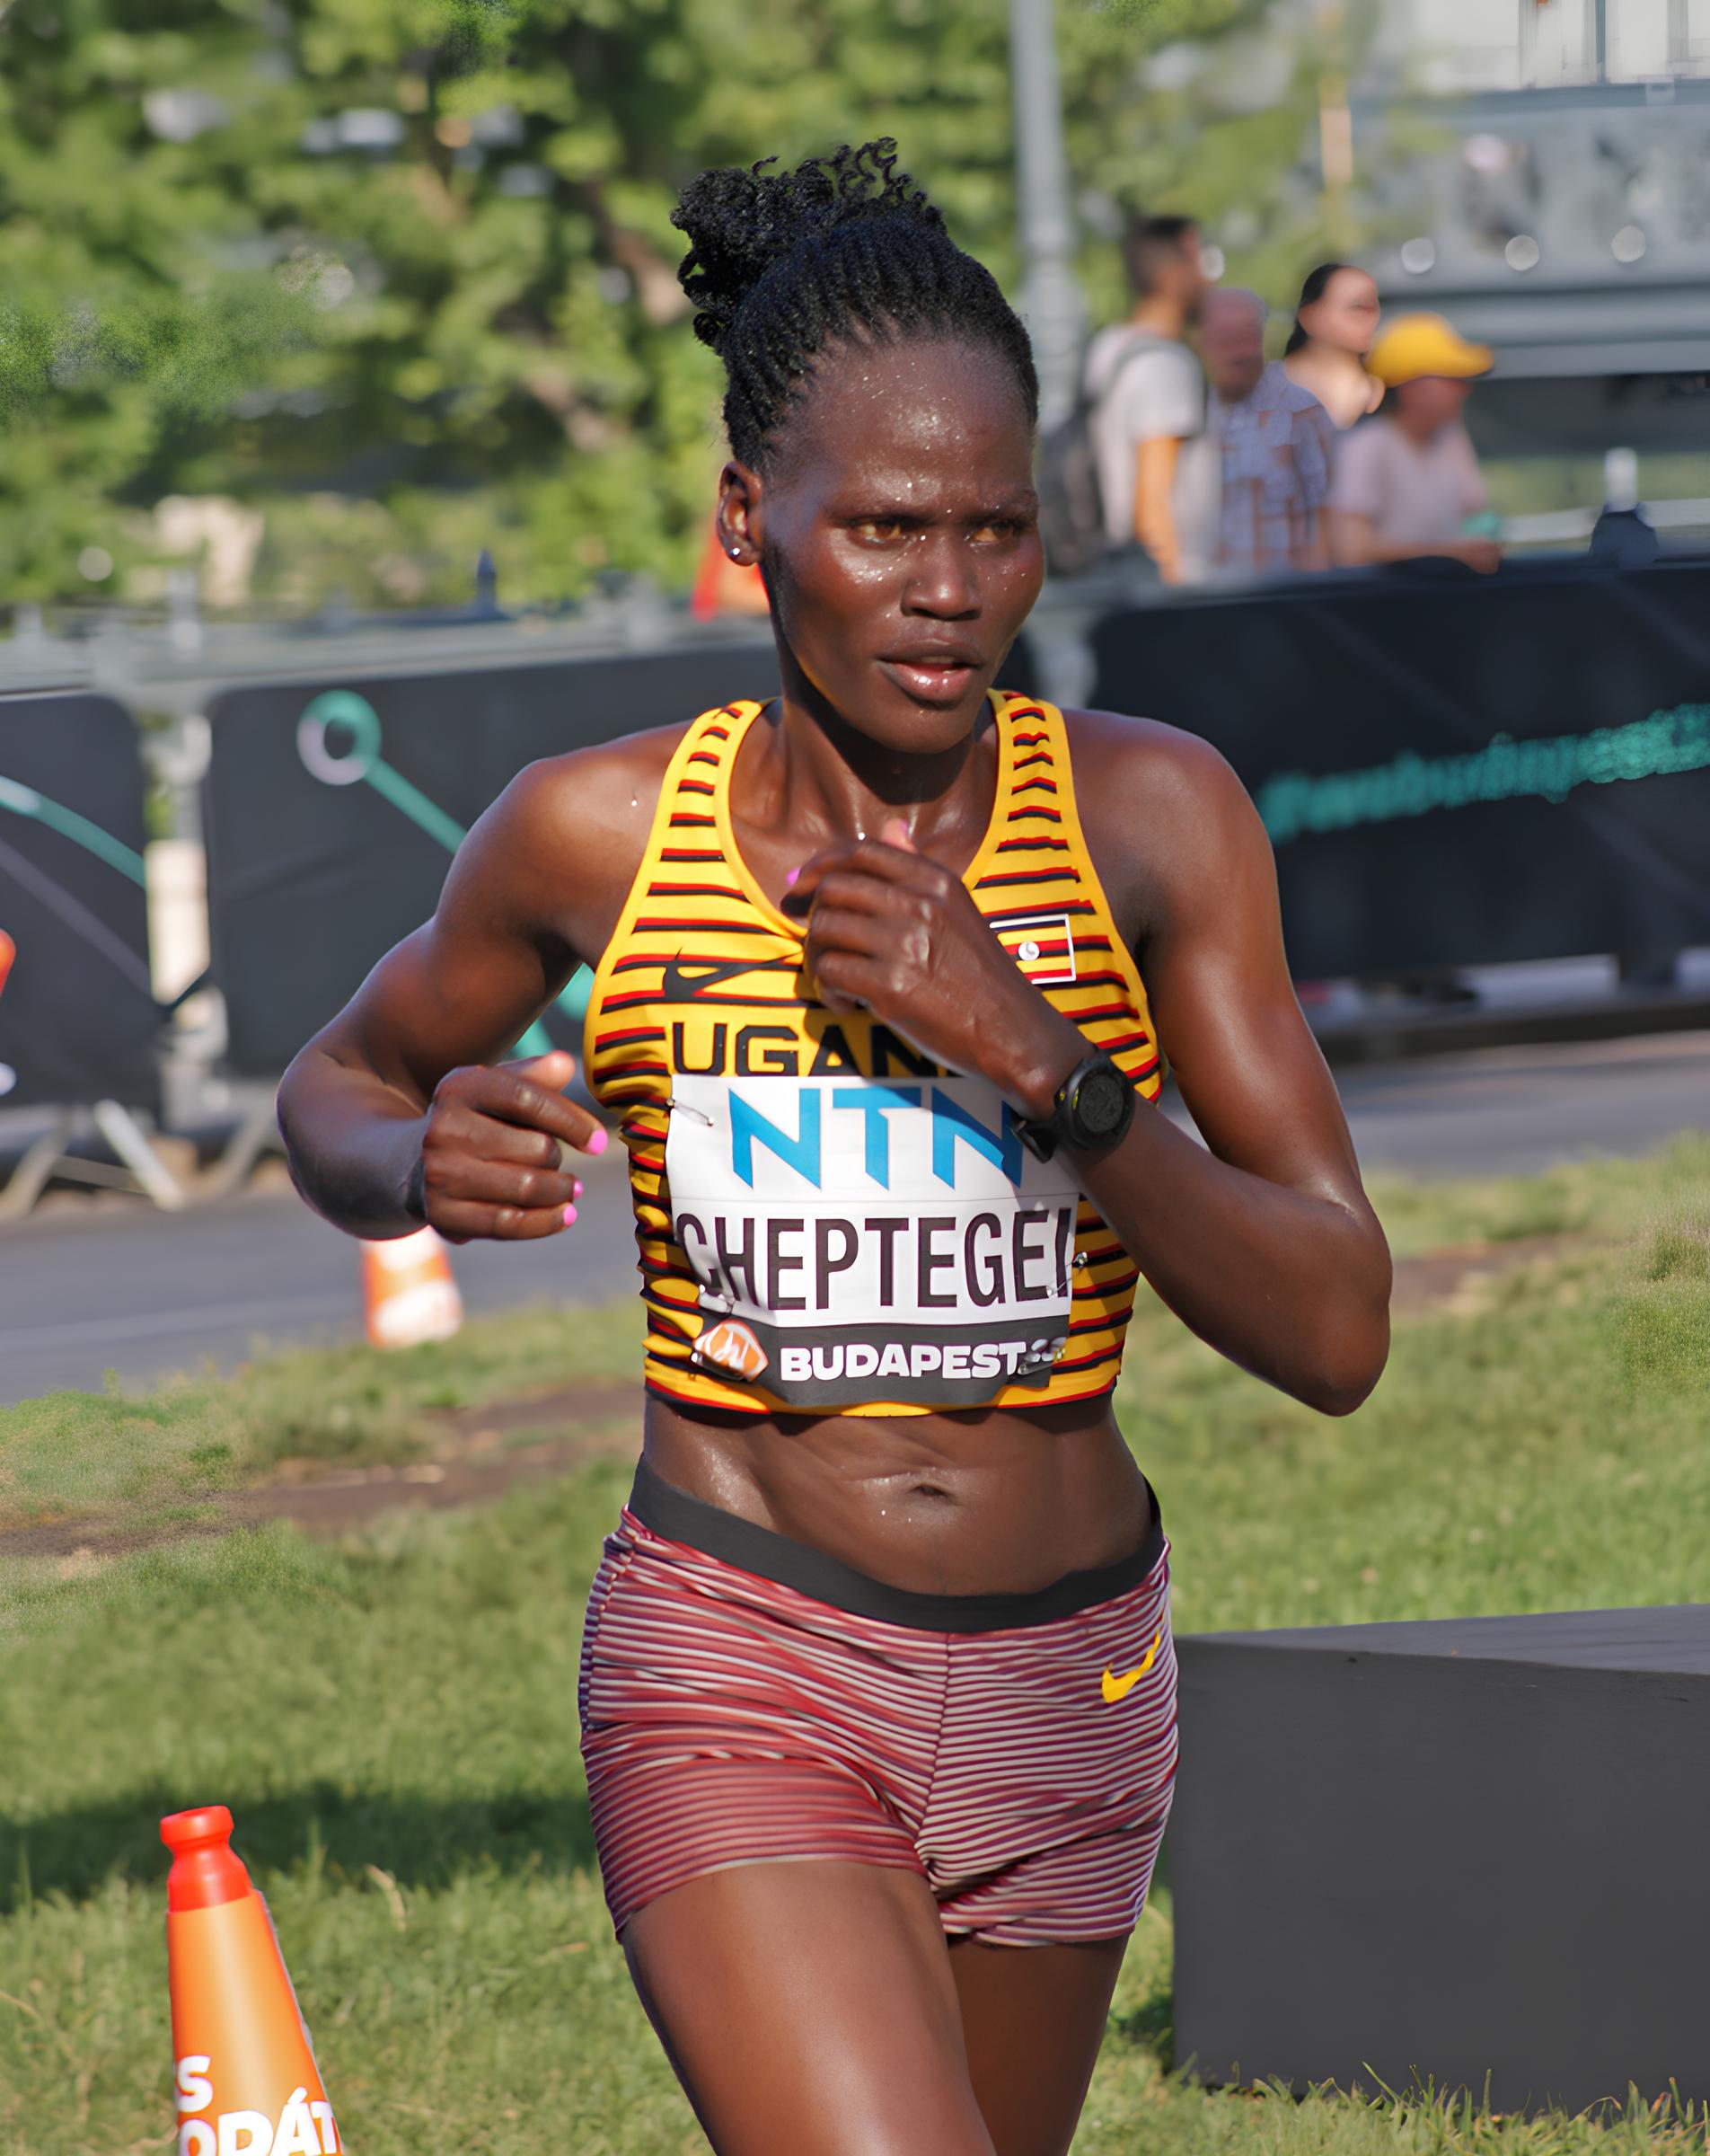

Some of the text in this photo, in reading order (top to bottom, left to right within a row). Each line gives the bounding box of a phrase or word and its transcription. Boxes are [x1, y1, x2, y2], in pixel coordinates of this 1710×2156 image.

[673, 1021, 965, 1077] UGAN
[728, 1087, 1024, 1191] NTN
[676, 1207, 1071, 1310] CHEPTEGEI
